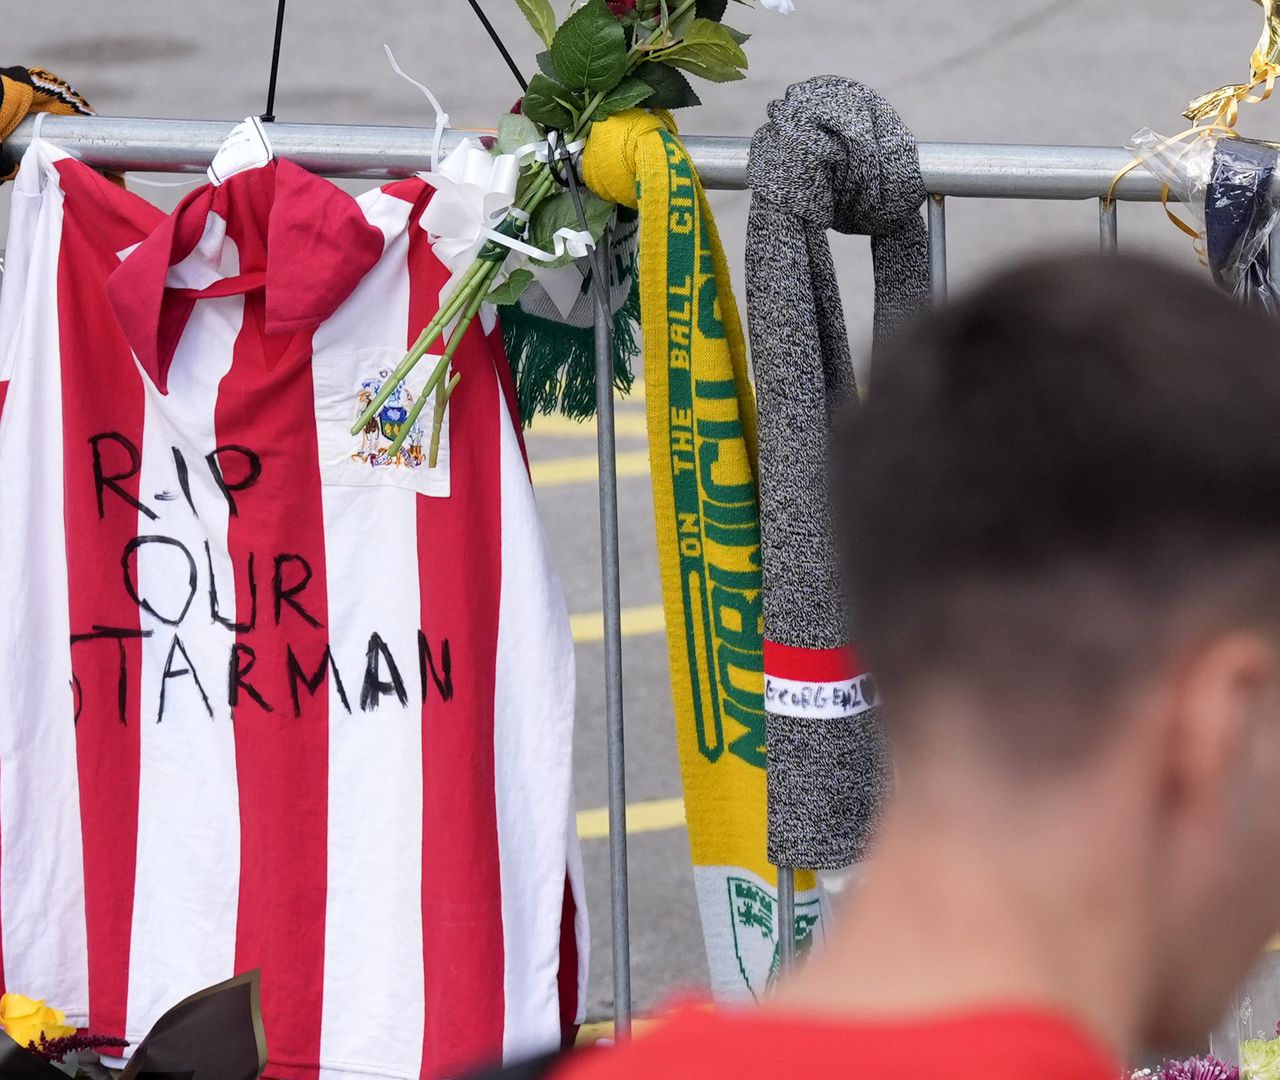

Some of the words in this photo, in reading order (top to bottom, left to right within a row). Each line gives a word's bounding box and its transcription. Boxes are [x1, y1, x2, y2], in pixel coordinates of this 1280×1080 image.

[666, 142, 692, 234] CITY
[667, 274, 692, 371] BALL
[672, 405, 695, 475] THE
[679, 512, 699, 557] ON
[121, 534, 325, 633] OUR
[69, 624, 454, 728] TARMAN
